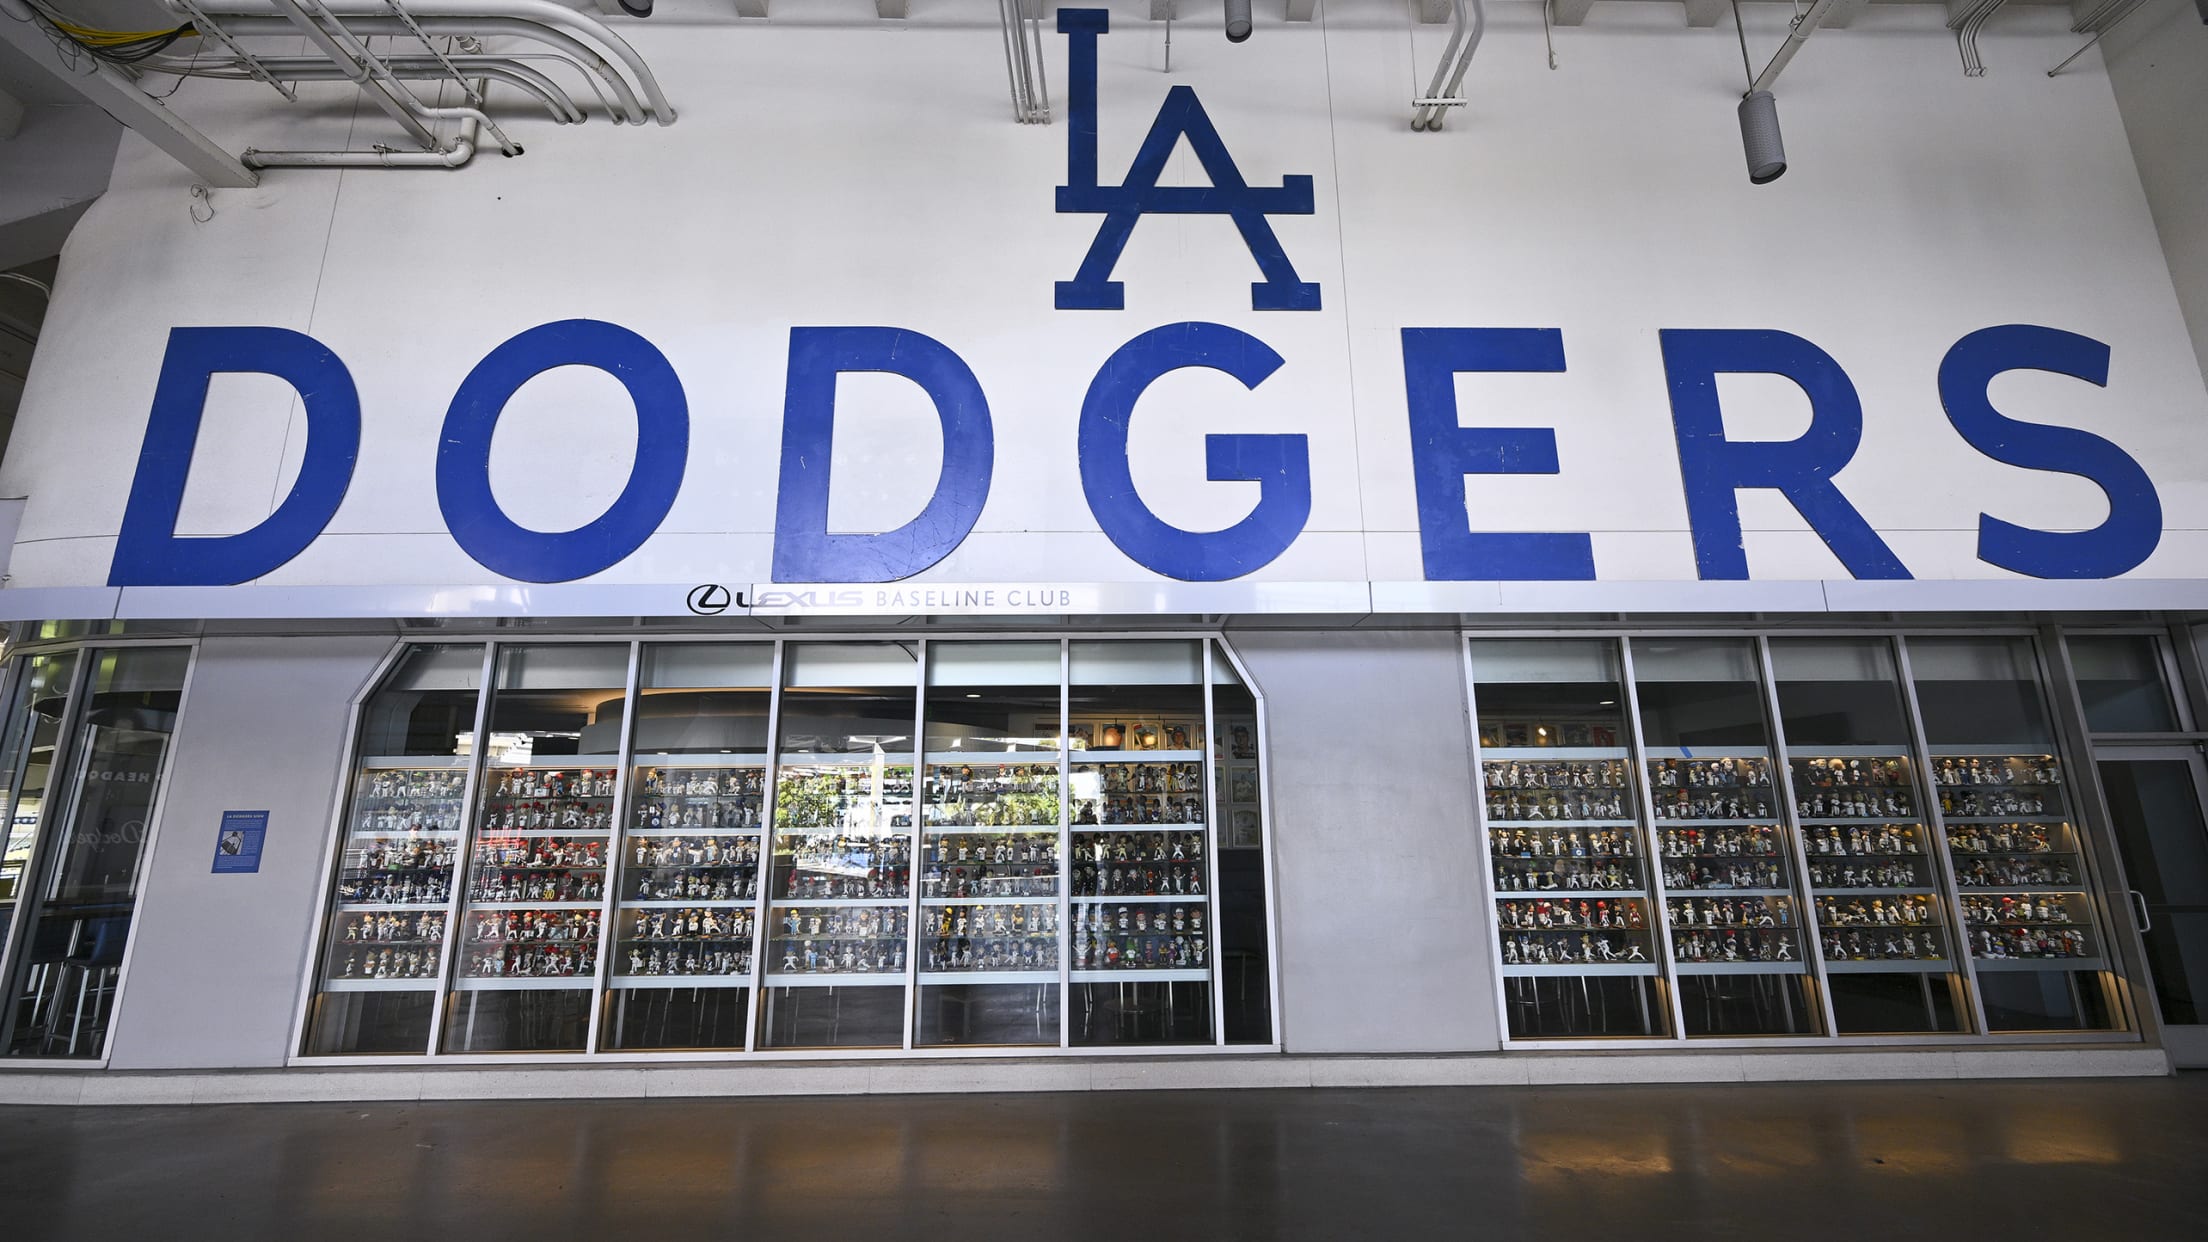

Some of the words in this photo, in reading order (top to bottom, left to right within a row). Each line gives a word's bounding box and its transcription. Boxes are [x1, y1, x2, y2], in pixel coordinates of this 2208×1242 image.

[1055, 8, 1322, 311] LA
[108, 318, 2164, 585] DODGERS
[736, 591, 864, 608] LEXUS
[876, 590, 995, 607] BASELINE
[1007, 590, 1071, 607] CLUB
